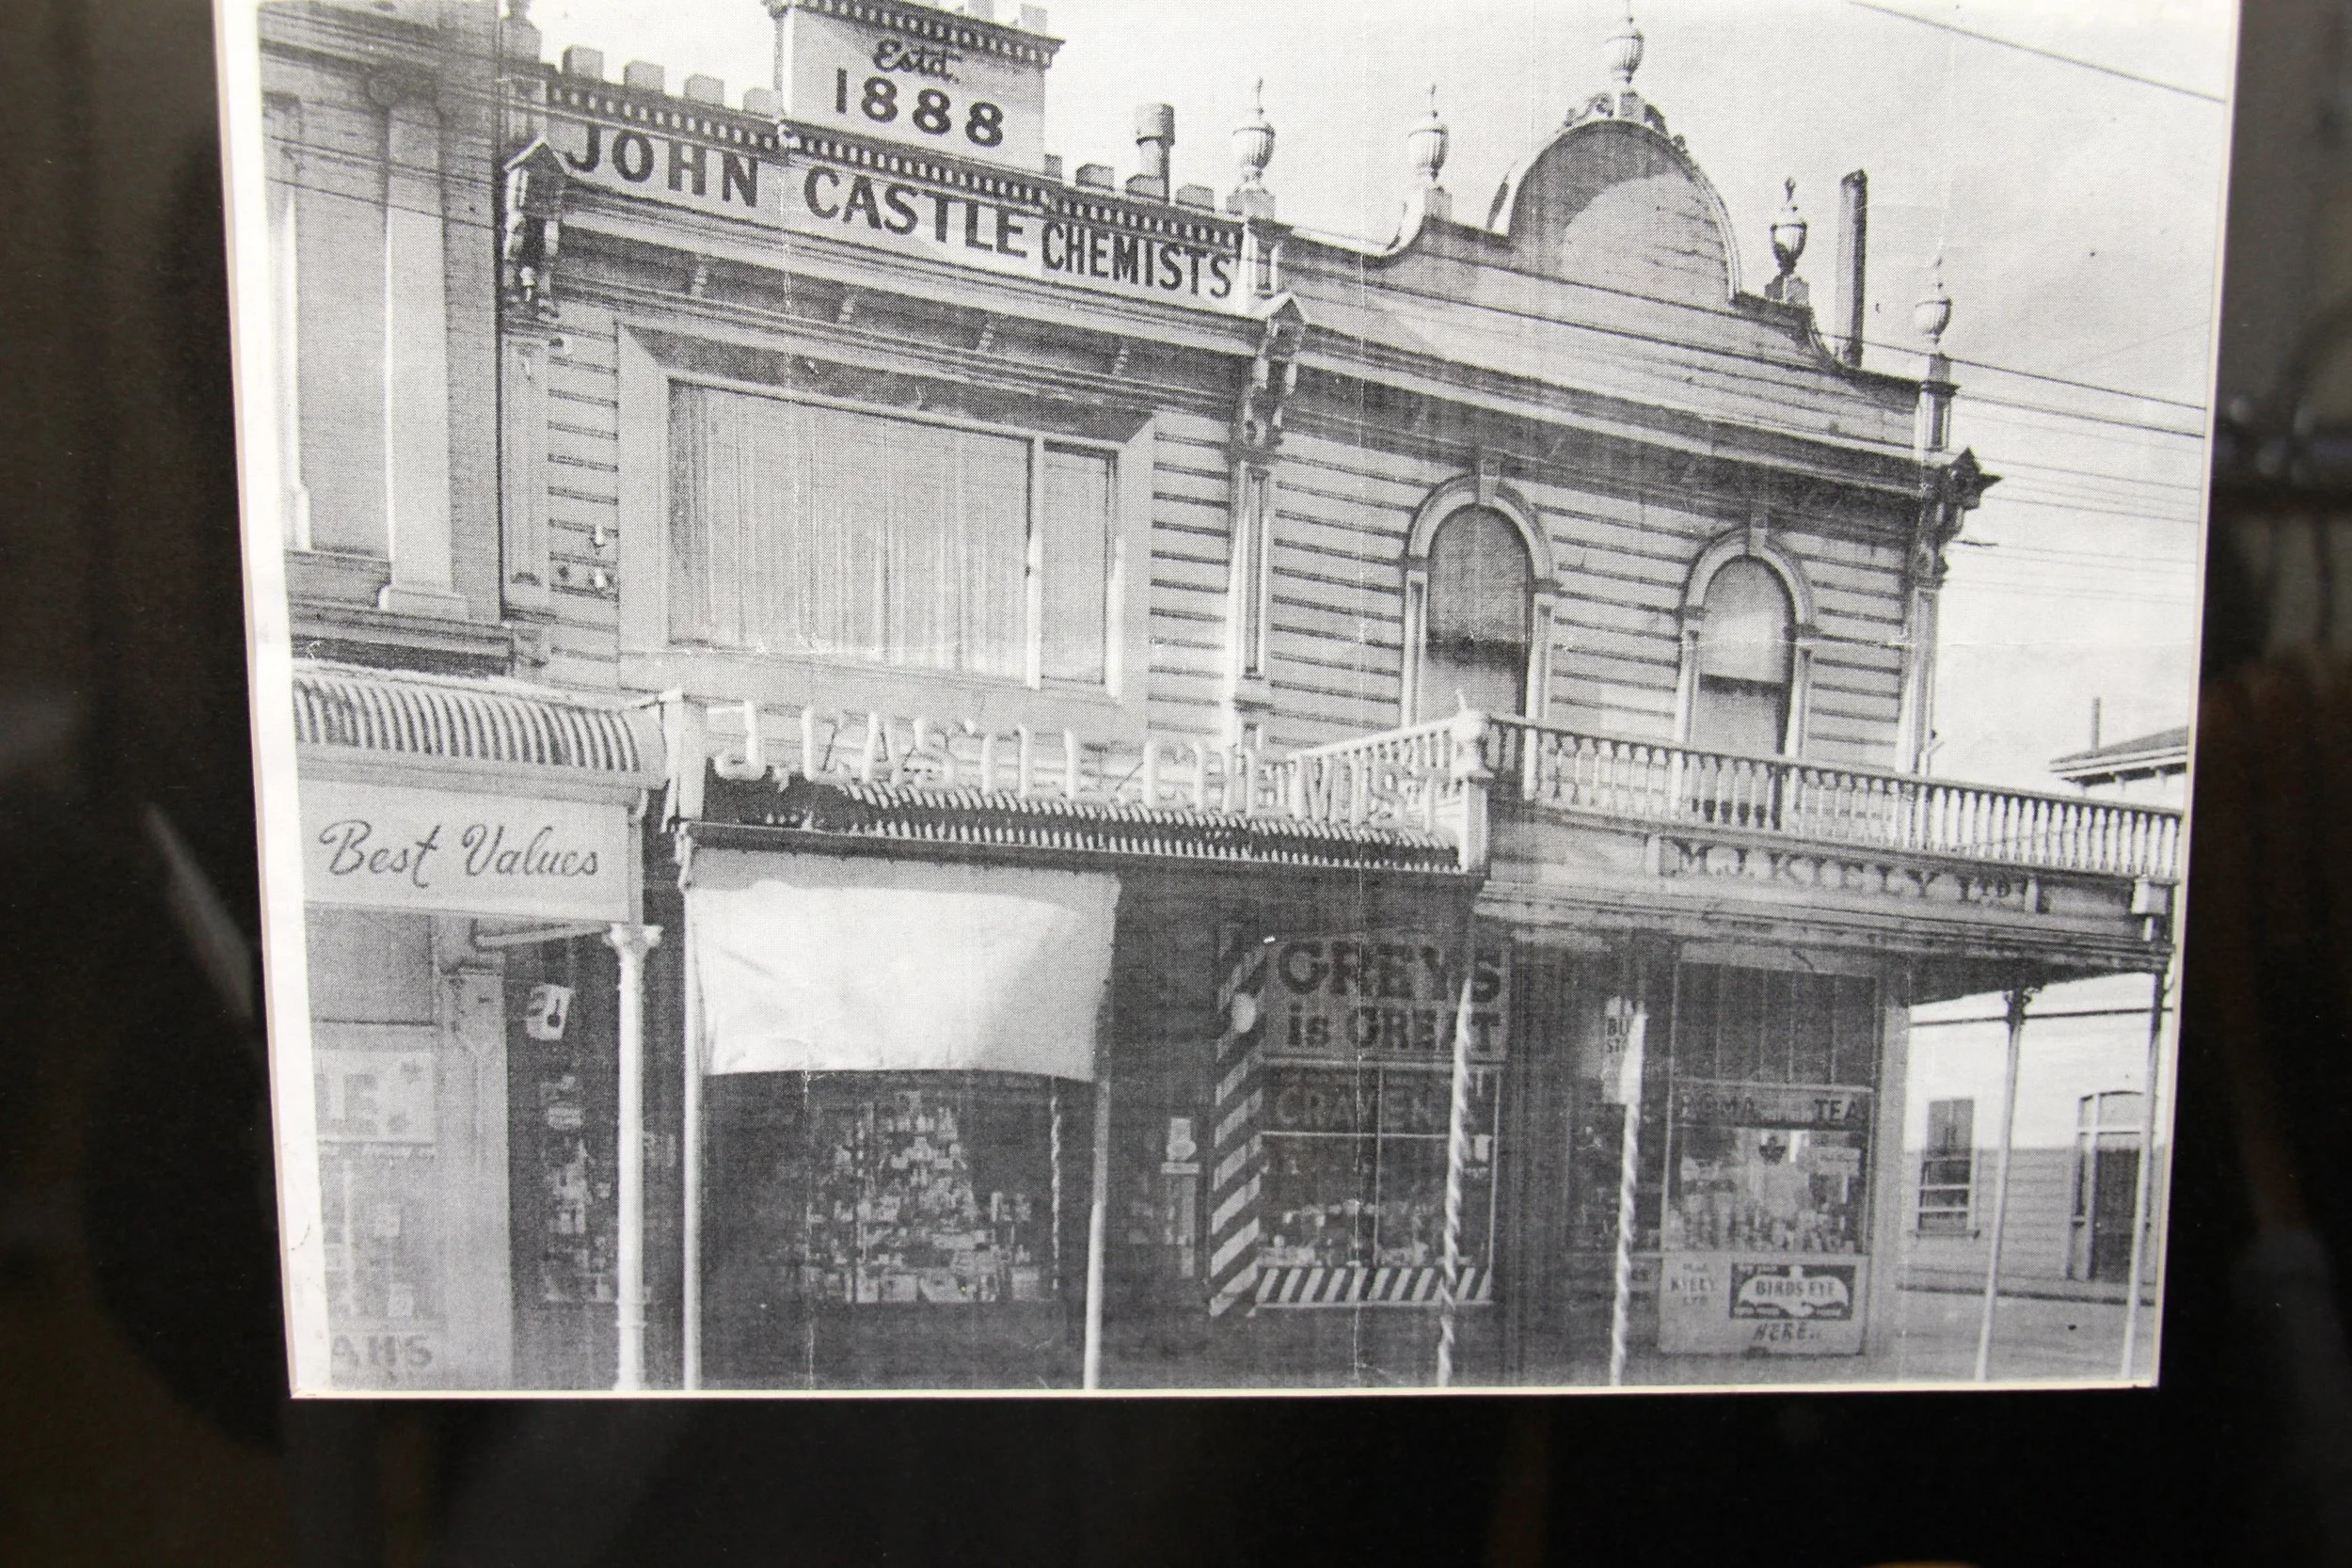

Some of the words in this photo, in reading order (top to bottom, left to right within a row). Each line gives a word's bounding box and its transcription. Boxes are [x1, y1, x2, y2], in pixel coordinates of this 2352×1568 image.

[835, 67, 1005, 148] 1888
[566, 123, 758, 208] JOHN
[803, 165, 1028, 259] CASTLE
[1042, 220, 1234, 301] CHEMISTS
[319, 818, 442, 889] Best
[461, 823, 599, 877] Values
[1287, 1002, 1332, 1047] is
[1814, 1098, 1863, 1121] TEA
[1755, 1280, 1804, 1297] BIRDS
[1808, 1280, 1836, 1296] EYE
